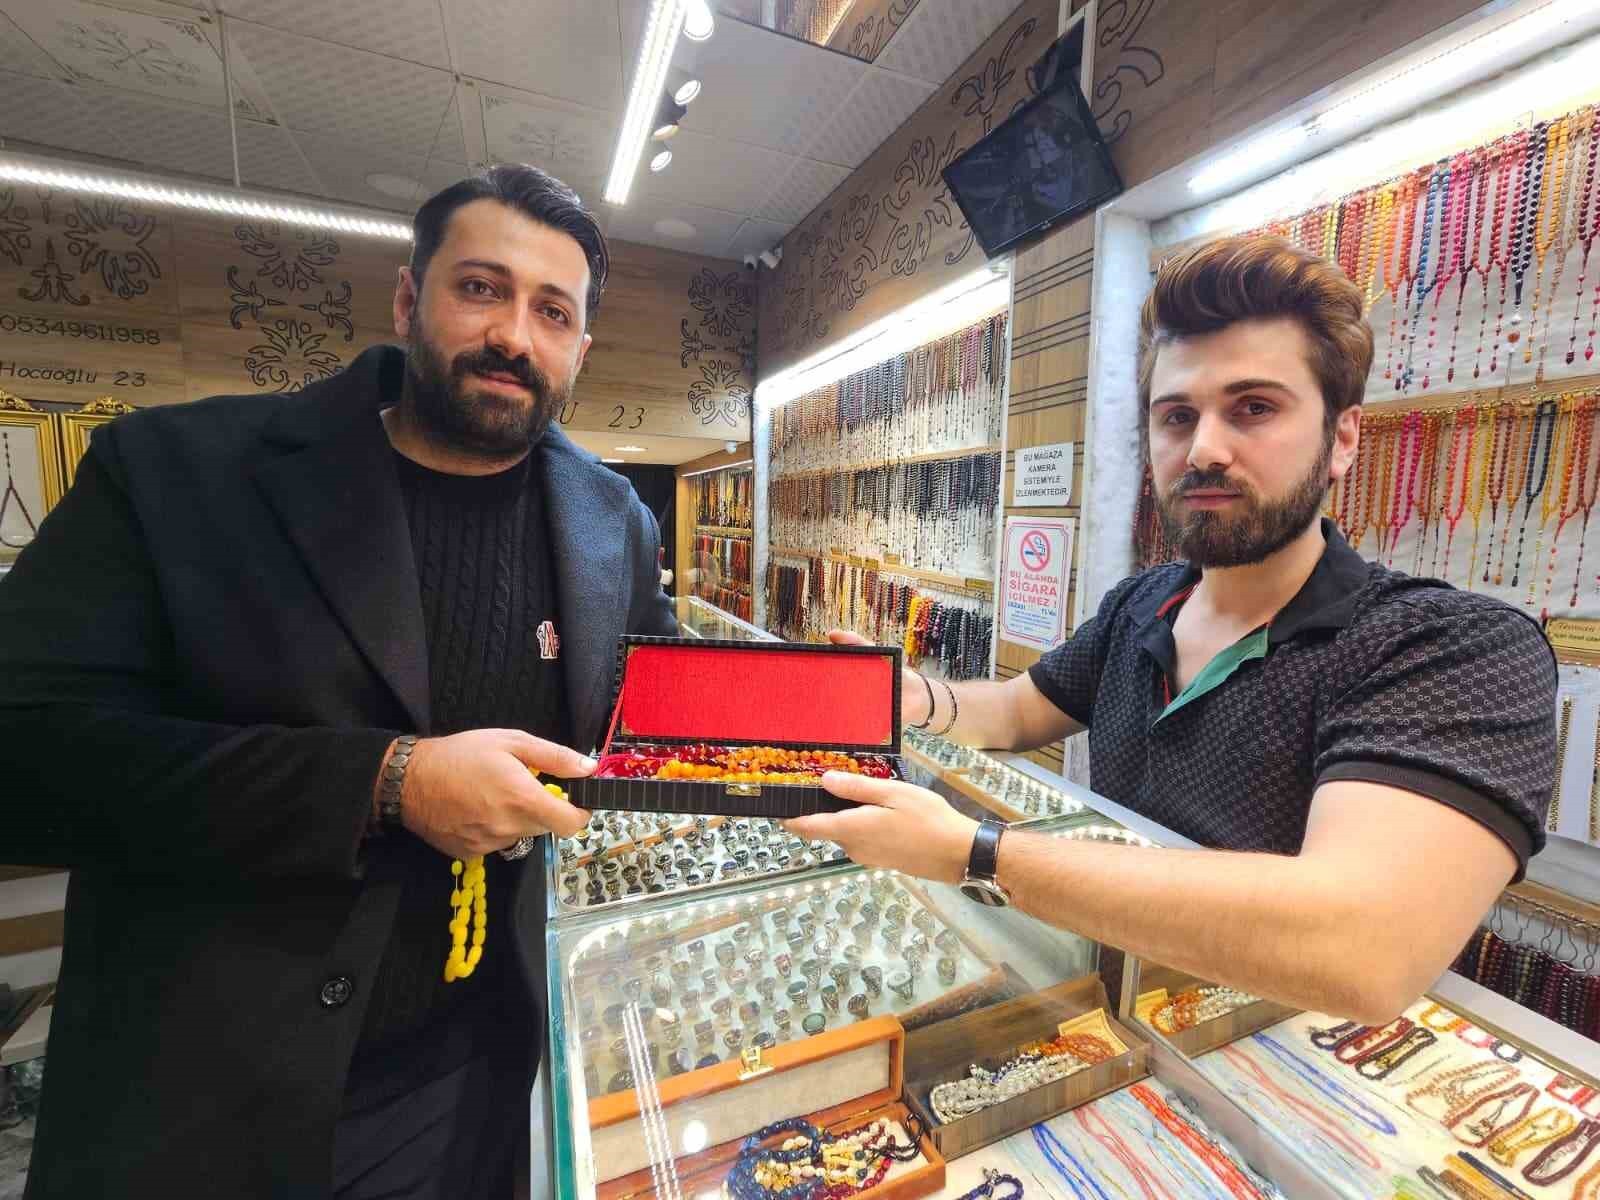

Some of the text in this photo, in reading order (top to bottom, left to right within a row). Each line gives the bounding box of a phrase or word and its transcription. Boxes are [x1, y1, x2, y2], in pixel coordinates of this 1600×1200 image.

[113, 371, 147, 387] 23
[607, 405, 646, 429] 23
[1028, 463, 1057, 473] KAMERA
